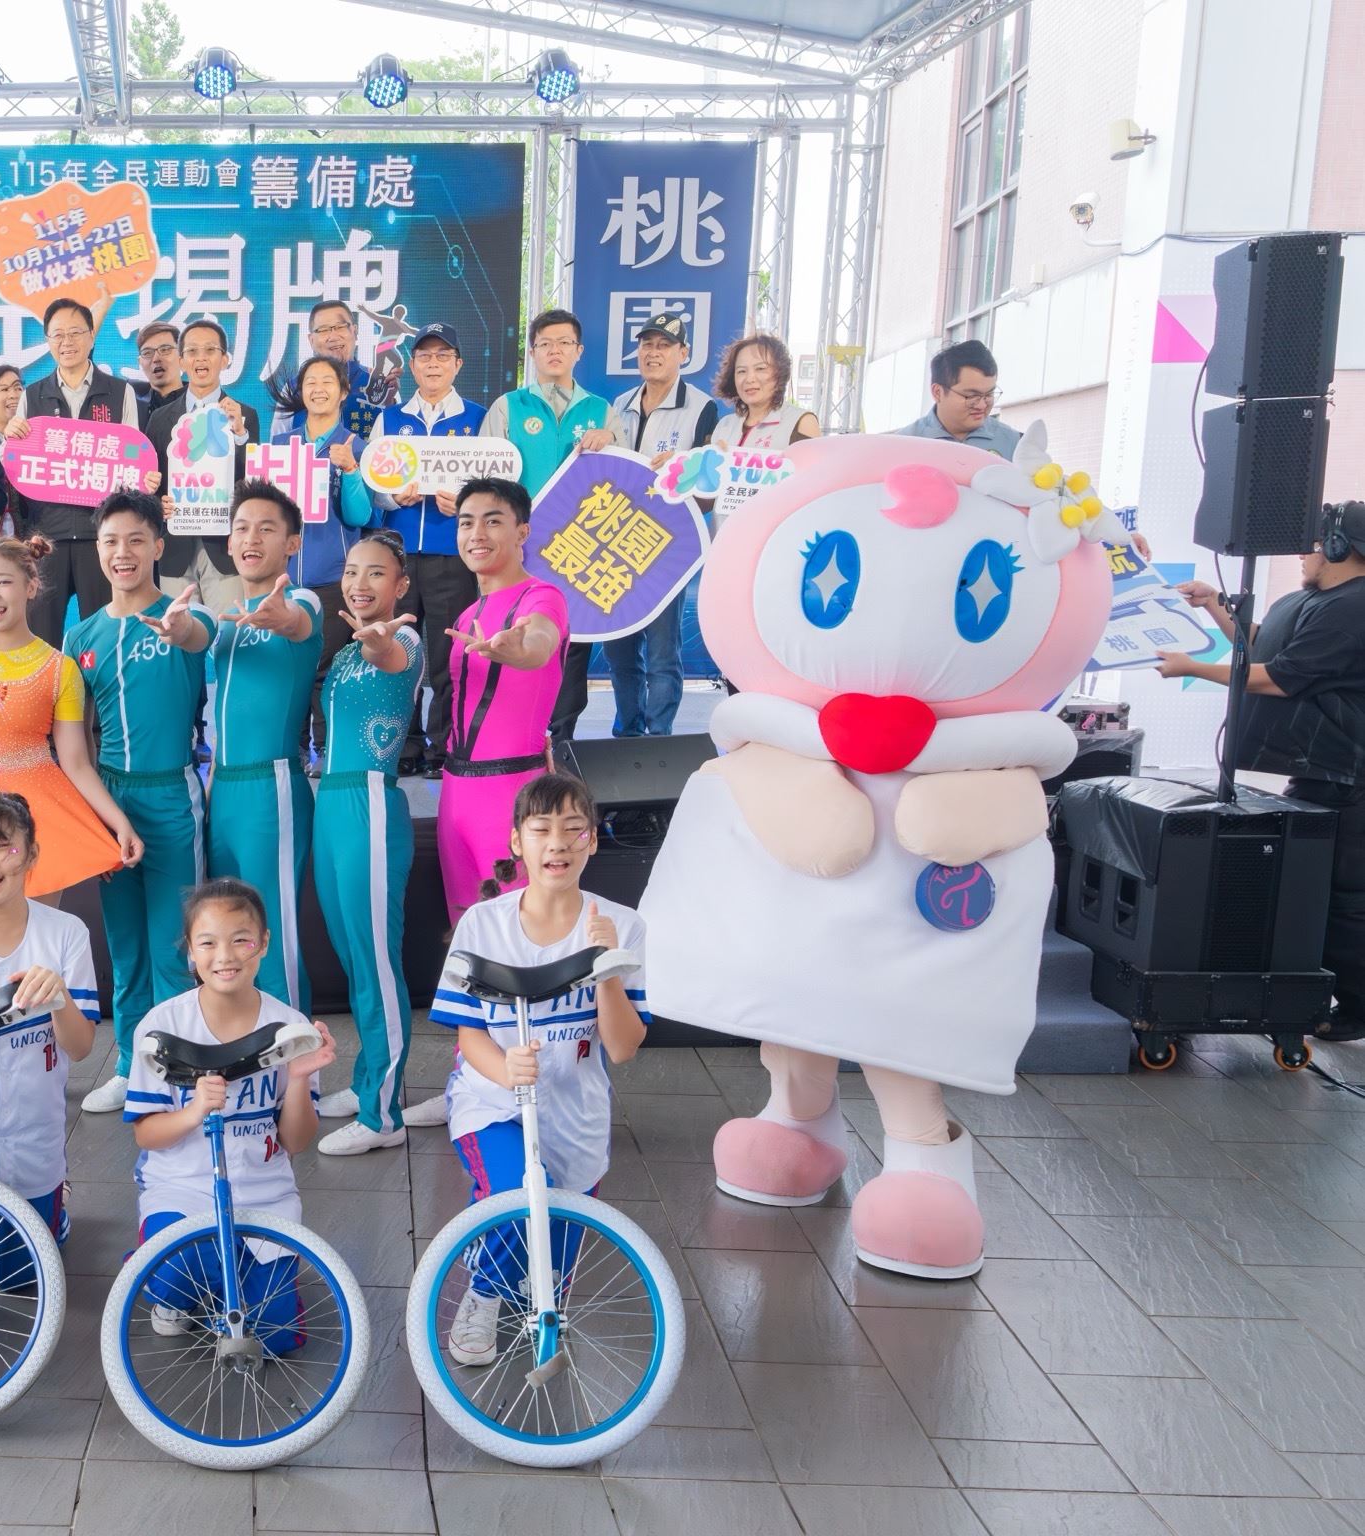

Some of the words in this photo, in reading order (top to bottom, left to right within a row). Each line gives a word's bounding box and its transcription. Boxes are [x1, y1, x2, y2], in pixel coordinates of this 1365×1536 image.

[251, 155, 415, 208] 籌備處
[33, 208, 88, 241] 115年
[2, 215, 135, 275] 10月17日-22日
[20, 233, 151, 297] 做伙來桃園
[43, 428, 121, 461] 籌備處
[17, 455, 140, 493] 正式揭牌
[171, 472, 215, 488] TAO
[421, 459, 514, 474] TAOYUAN
[171, 488, 229, 503] YUAN
[575, 482, 674, 576] 桃園
[540, 521, 633, 615] 最強
[127, 636, 171, 662] 456
